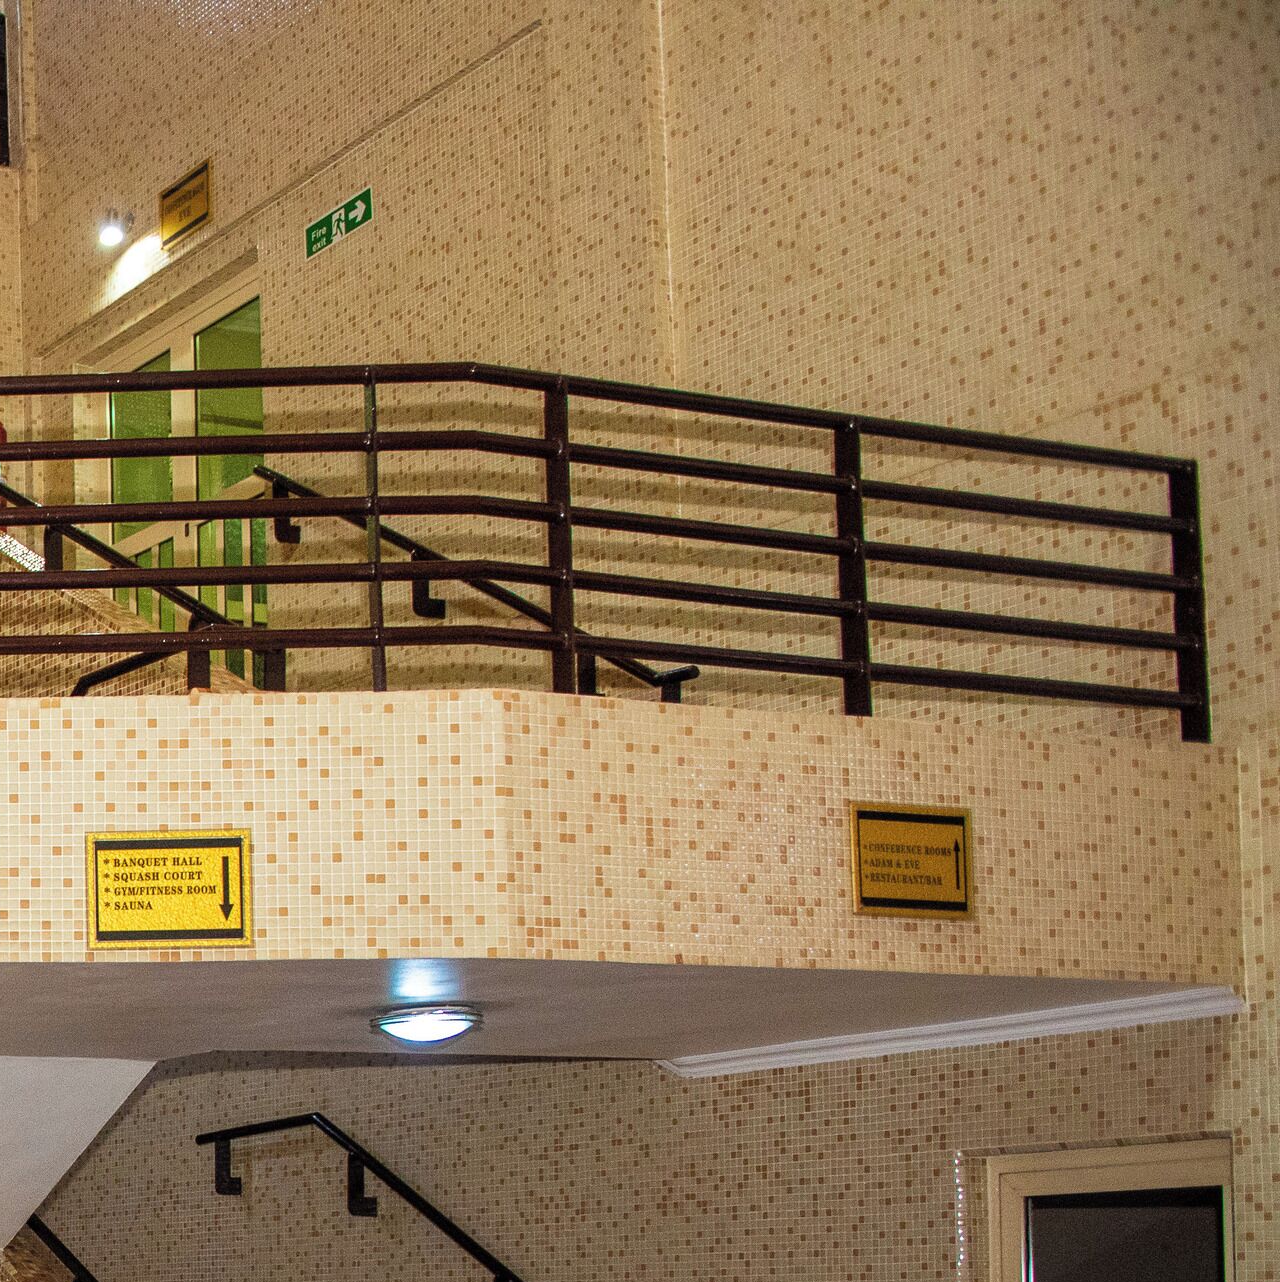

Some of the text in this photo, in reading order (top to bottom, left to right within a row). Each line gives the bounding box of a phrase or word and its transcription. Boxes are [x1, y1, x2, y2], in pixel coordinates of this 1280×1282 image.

[311, 226, 327, 241] Fire
[312, 237, 326, 252] exit
[868, 843, 952, 856] CONFERENCE ROOMS
[113, 856, 202, 867] BANQUET HALL
[869, 857, 893, 867] ADAM
[904, 860, 920, 868] EVE
[113, 871, 203, 882] SQUASH COURT
[870, 872, 943, 885] RESTAURANT/BAR
[114, 885, 217, 895] GYM/FITNESS ROOM
[114, 901, 153, 910] SAUNA
